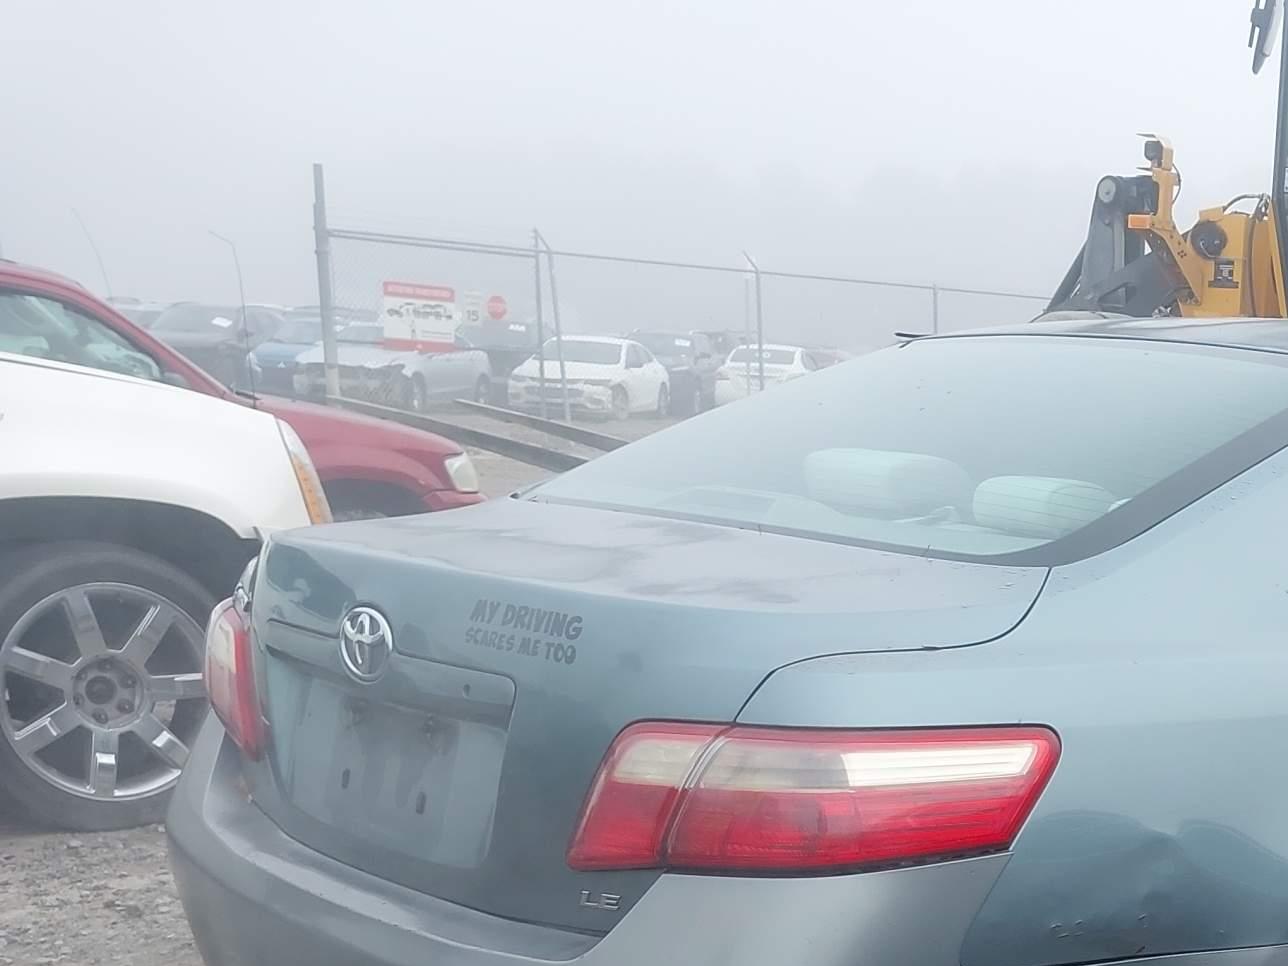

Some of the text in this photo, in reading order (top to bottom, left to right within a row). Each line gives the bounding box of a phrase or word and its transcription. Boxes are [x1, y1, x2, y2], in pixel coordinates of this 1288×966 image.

[470, 599, 583, 640] MY DRIVING
[465, 626, 577, 665] SCARES ME TOO
[580, 890, 621, 910] LE
